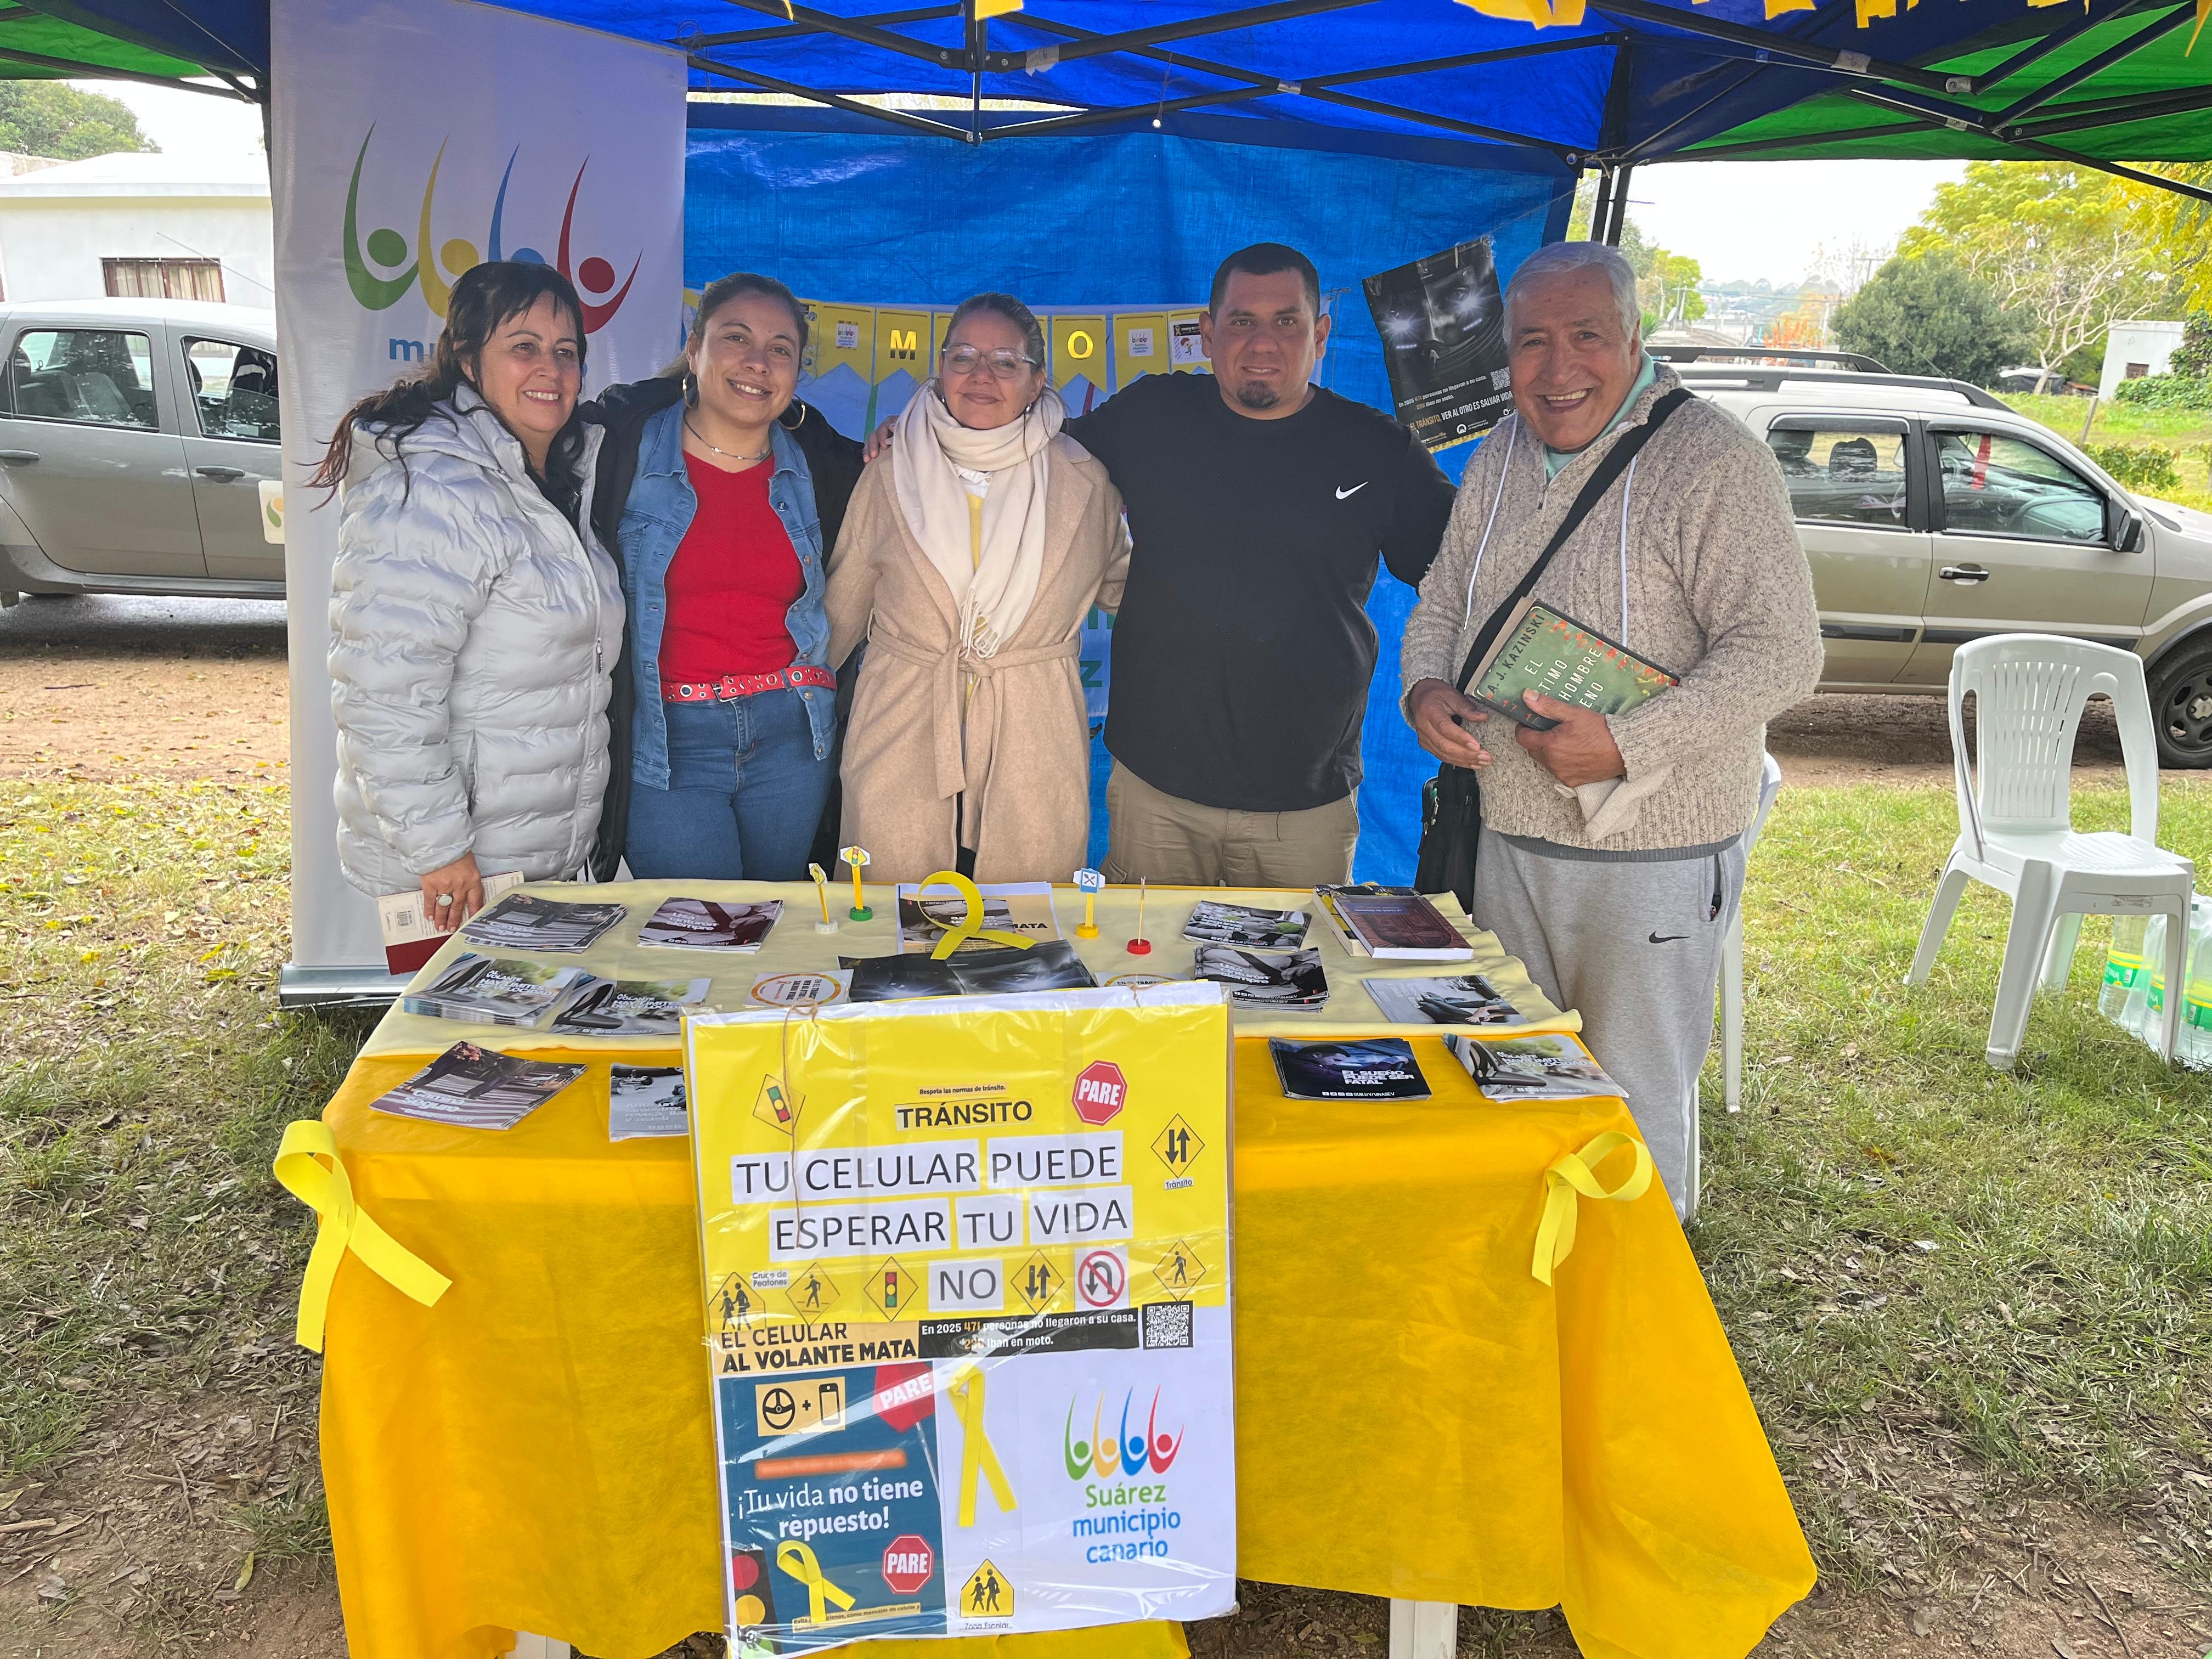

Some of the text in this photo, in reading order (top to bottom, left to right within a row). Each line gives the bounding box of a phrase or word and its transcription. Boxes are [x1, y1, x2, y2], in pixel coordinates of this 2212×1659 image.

[890, 329, 1093, 360] M O
[1422, 390, 1442, 400] personas
[1448, 382, 1466, 391] llegaron
[1441, 410, 1453, 421] VER
[1453, 409, 1460, 417] AL
[1460, 404, 1473, 415] OTRO
[1473, 402, 1480, 410] ES
[1480, 396, 1500, 408] SALVAR
[1498, 670, 1507, 681] J.
[1506, 615, 1545, 669] KAZINSKI
[1525, 659, 1544, 675] EL
[1538, 658, 1568, 696] TIMO
[1558, 647, 1602, 702] HOMBRE
[1579, 681, 1604, 709] ENO
[496, 986, 553, 996] VELOCIDAD
[1080, 1079, 1121, 1106] PARE
[897, 1101, 1032, 1128] TRÁNSITO
[736, 1146, 1118, 1193] TU CELULAR PUEDE
[1165, 1178, 1193, 1189] Tránsito
[776, 1200, 1127, 1250] ESPERAR TU VIDA
[940, 1269, 997, 1300] NO
[721, 1323, 848, 1349] EL CELULAR
[922, 1325, 934, 1335] En
[936, 1323, 961, 1334] 2025
[964, 1321, 980, 1331] 471
[983, 1320, 1029, 1333] personas
[1046, 1316, 1086, 1328] llegaron
[1097, 1315, 1109, 1324] su
[1111, 1314, 1136, 1323] casa.
[1026, 1336, 1053, 1345] moto.
[723, 1339, 917, 1373] AL VOLANTE MATA
[880, 1373, 933, 1410] PARE
[738, 1478, 923, 1519] ¡Tu vida no tiene
[1085, 1482, 1166, 1508] Suárez
[779, 1506, 890, 1541] repuesto!
[1073, 1506, 1181, 1538] municipio
[887, 1554, 928, 1574] PARE
[1086, 1537, 1168, 1564] canario
